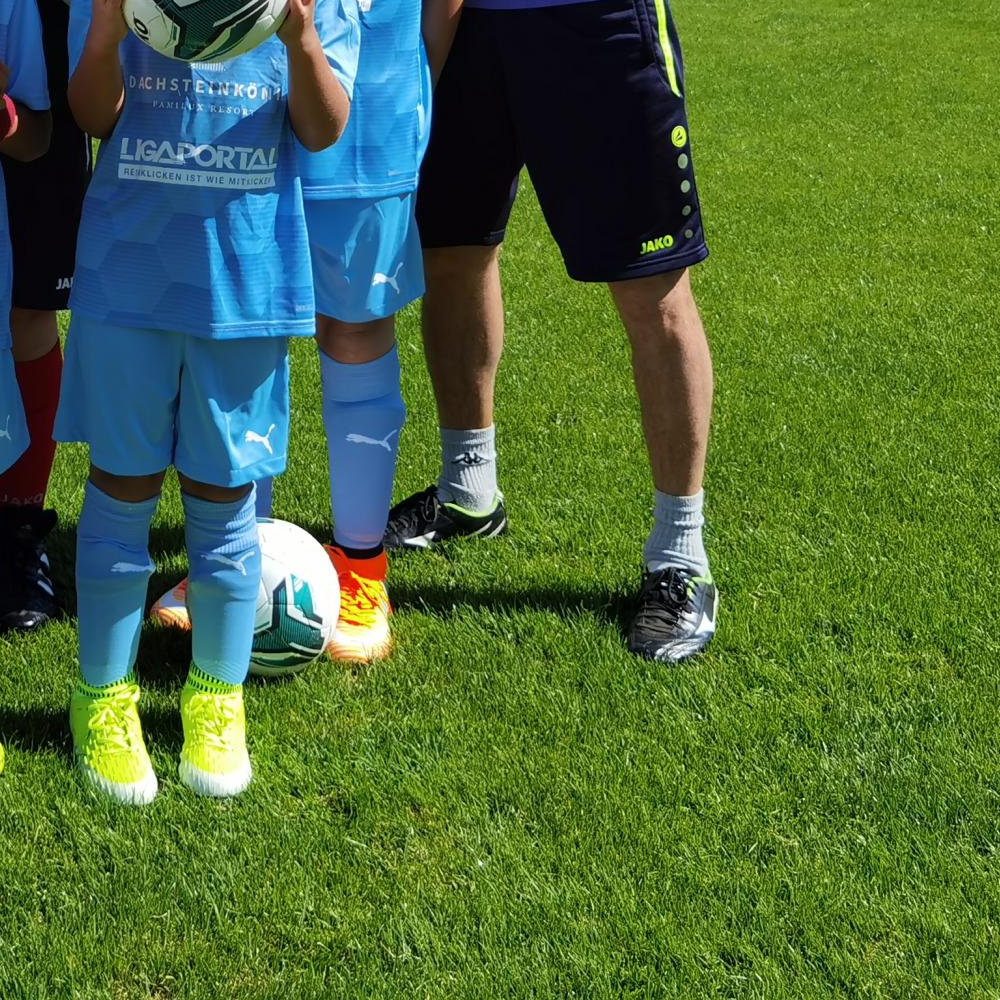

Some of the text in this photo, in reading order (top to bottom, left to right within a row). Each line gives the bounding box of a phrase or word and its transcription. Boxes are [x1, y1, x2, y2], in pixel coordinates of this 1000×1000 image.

[129, 75, 282, 101] DACHSTEINKÖNI
[119, 137, 278, 170] LIGAPORTAL
[124, 168, 182, 181] REINKLICKEN
[186, 174, 201, 182] IST
[206, 176, 225, 184] WIE
[640, 235, 674, 255] JAKO
